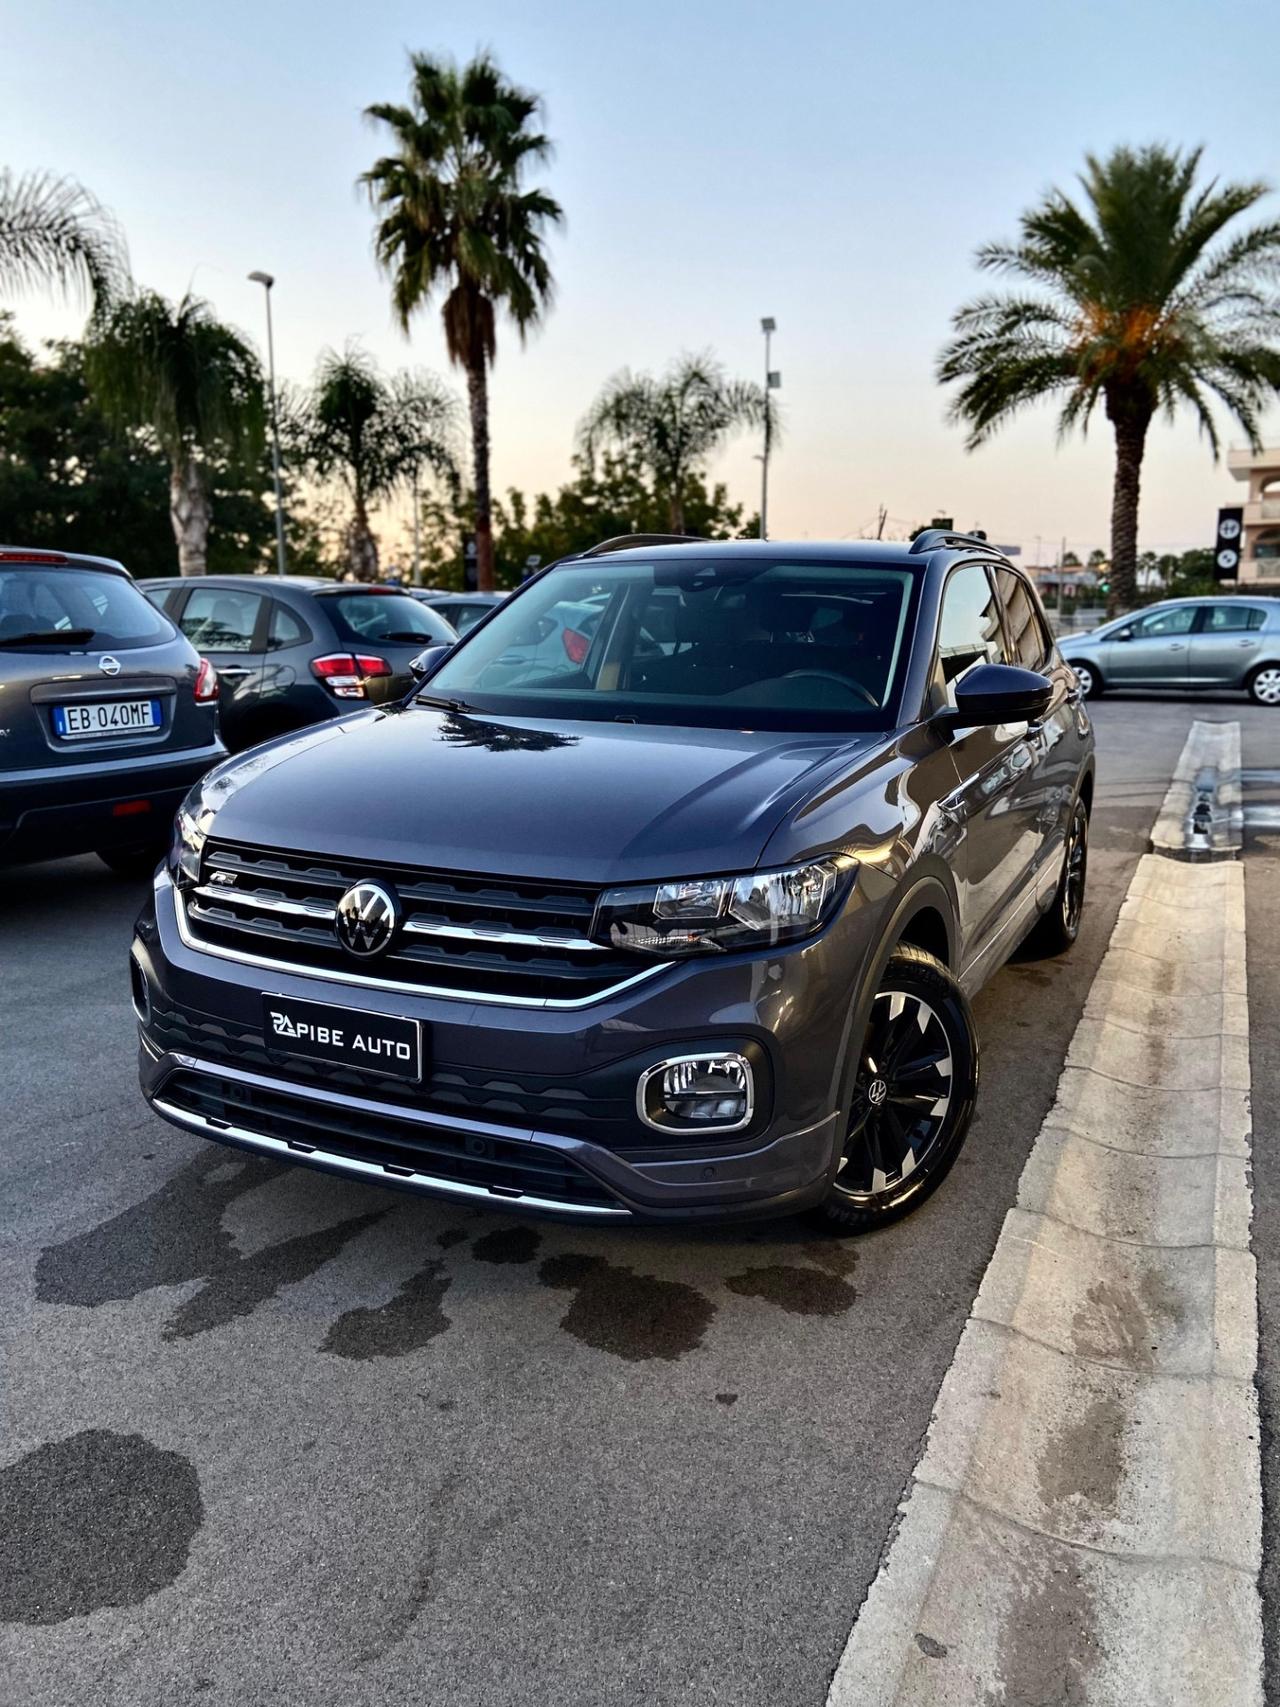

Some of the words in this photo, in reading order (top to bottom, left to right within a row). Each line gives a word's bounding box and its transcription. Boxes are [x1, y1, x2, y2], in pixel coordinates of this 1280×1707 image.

[67, 707, 91, 731] EB
[98, 703, 150, 728] 040MF
[352, 1034, 411, 1061] AUTO
